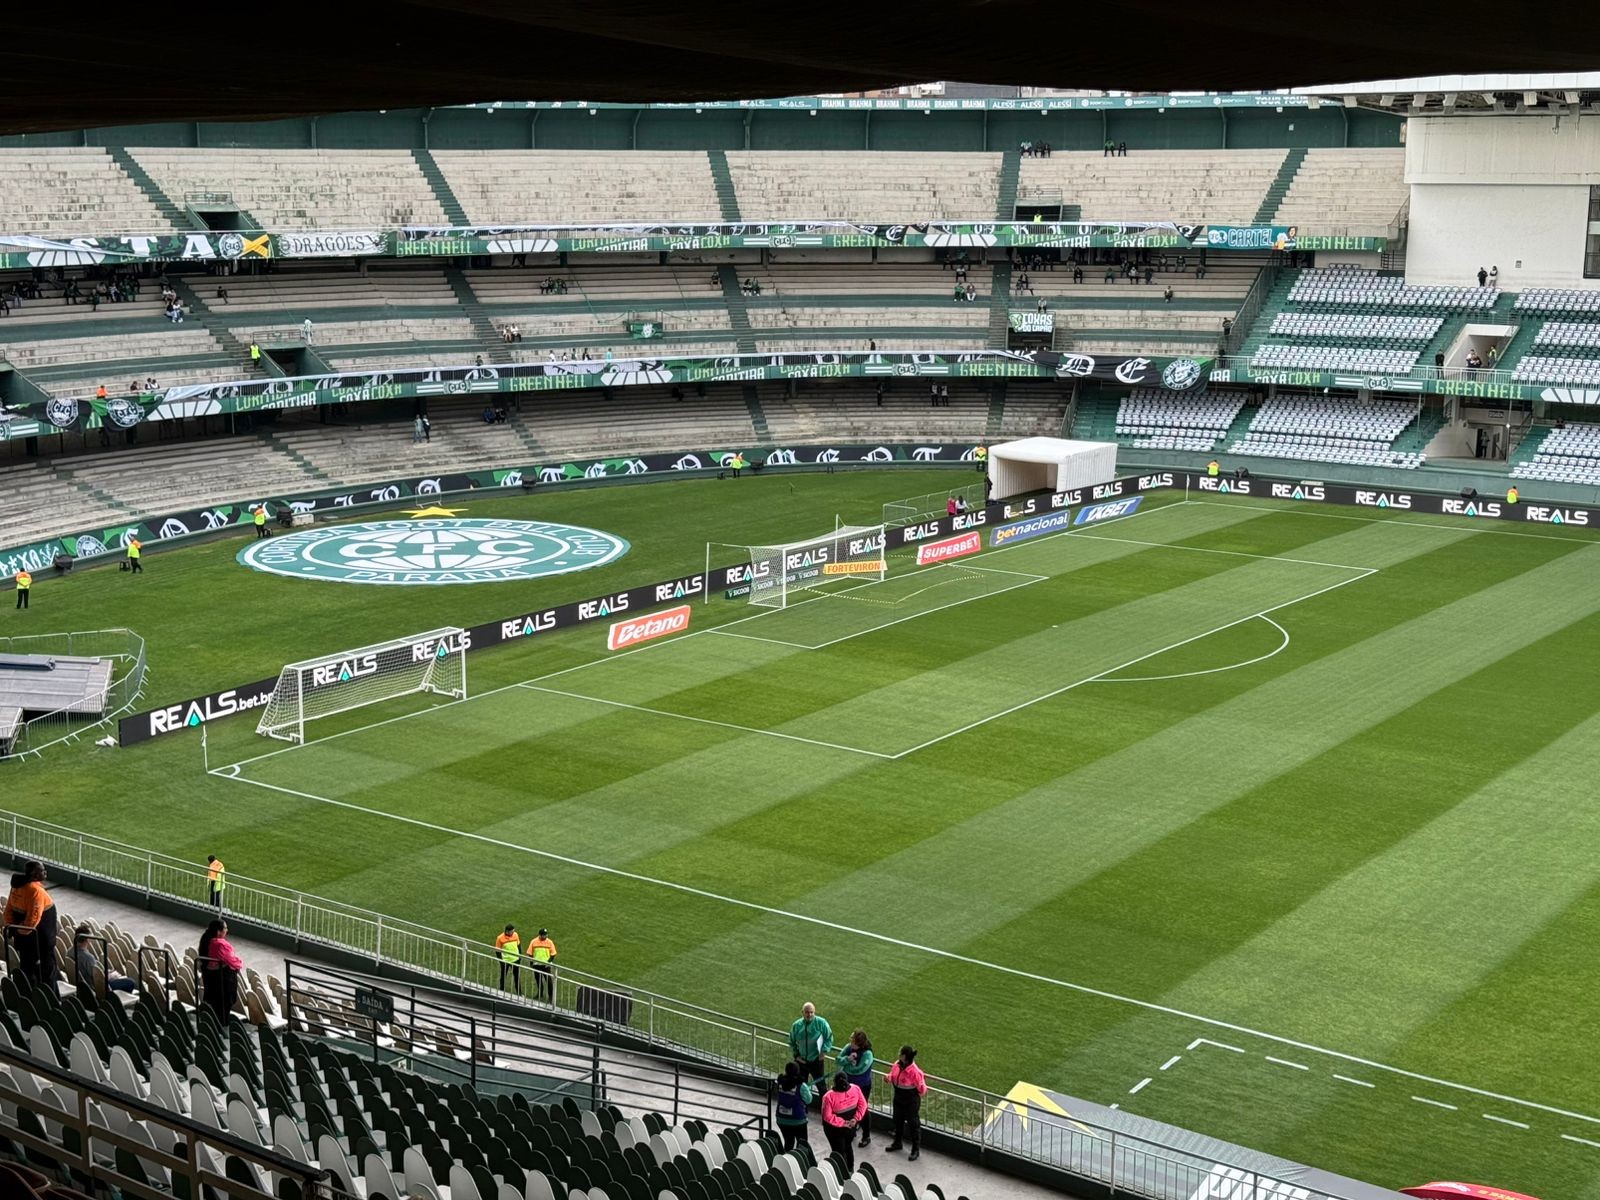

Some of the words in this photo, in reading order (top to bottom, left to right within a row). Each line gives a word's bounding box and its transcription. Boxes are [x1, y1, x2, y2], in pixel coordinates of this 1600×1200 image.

[1228, 229, 1274, 247] CARTEL
[510, 375, 553, 391] GREEN
[555, 373, 586, 388] HELL
[1436, 380, 1482, 398] GREEN
[1487, 384, 1524, 401] HELL
[1093, 482, 1122, 500] REALS
[1138, 473, 1173, 490] REALS
[1199, 476, 1250, 495] REALS
[1271, 483, 1325, 501] REALS
[1051, 491, 1081, 508] REALS
[1355, 490, 1411, 509] REALS
[1442, 499, 1501, 517] REALS
[952, 510, 986, 531] REALS
[1085, 500, 1137, 522] 1XBET
[1526, 506, 1588, 525] REALS
[903, 521, 938, 542] REALS
[996, 513, 1068, 542] betnacional
[261, 528, 358, 564] CORITIBA
[362, 520, 471, 531] FOOT
[484, 521, 569, 536] BALL
[566, 534, 611, 556] CLUB
[339, 540, 535, 558] CFC
[850, 534, 886, 556] REALS
[924, 535, 979, 559] SUPERBET
[787, 547, 828, 570] REALS
[827, 562, 882, 574] FORTEVIRON
[726, 561, 769, 584] REALS
[656, 576, 702, 601] REALS
[578, 593, 628, 620] REALS
[502, 611, 556, 640] REALS
[617, 613, 684, 645] Betano
[412, 631, 471, 663] REALS
[313, 655, 377, 687] REALS
